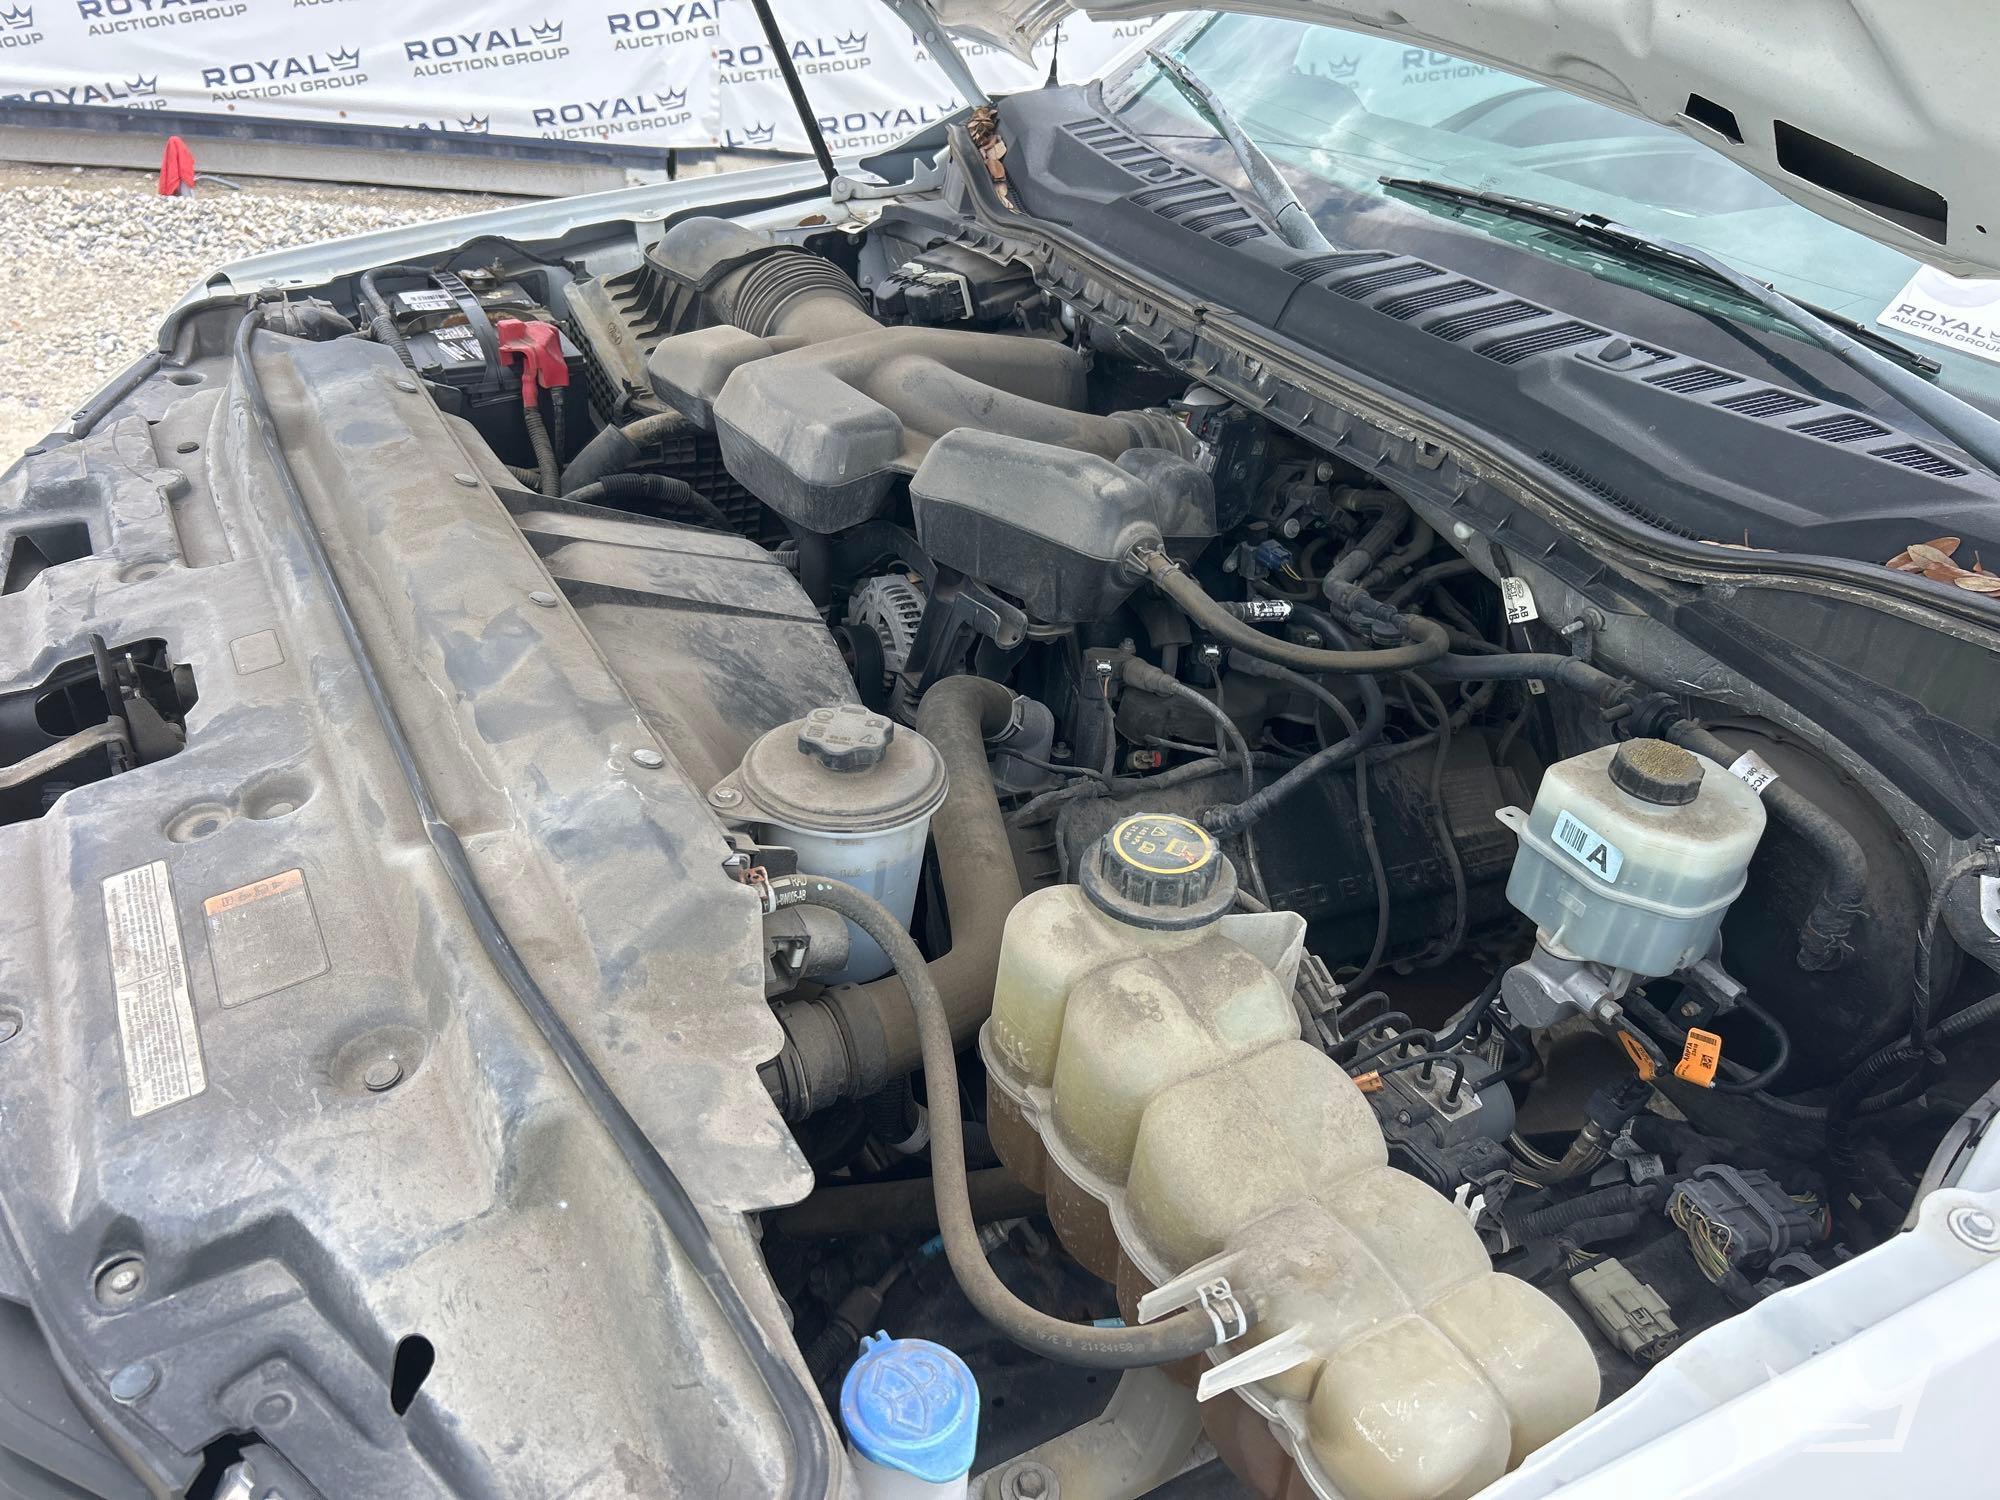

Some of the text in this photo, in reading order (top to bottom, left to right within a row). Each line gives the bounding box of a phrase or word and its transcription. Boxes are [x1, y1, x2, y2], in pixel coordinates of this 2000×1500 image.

[88, 3, 248, 36] AUCTION GROUP
[0, 32, 44, 48] OUP
[404, 27, 532, 62] ROYAL
[613, 28, 698, 51] AUCTION
[719, 37, 835, 69] ROAL
[200, 54, 330, 88] ROYAL
[413, 47, 570, 78] AUCTION GROUP
[806, 57, 871, 75] GROUP
[211, 73, 369, 102] AUCTION GROUP
[533, 95, 657, 127] ROYAL
[542, 111, 692, 140] AUCTION GROUP
[818, 106, 936, 135] ROYAL
[832, 127, 904, 150] UCTION
[1890, 315, 1954, 337] AUCTION
[1896, 303, 1986, 339] ROYAL
[1518, 605, 1529, 618] AB
[1586, 843, 1608, 874] A
[791, 876, 808, 887] RAD
